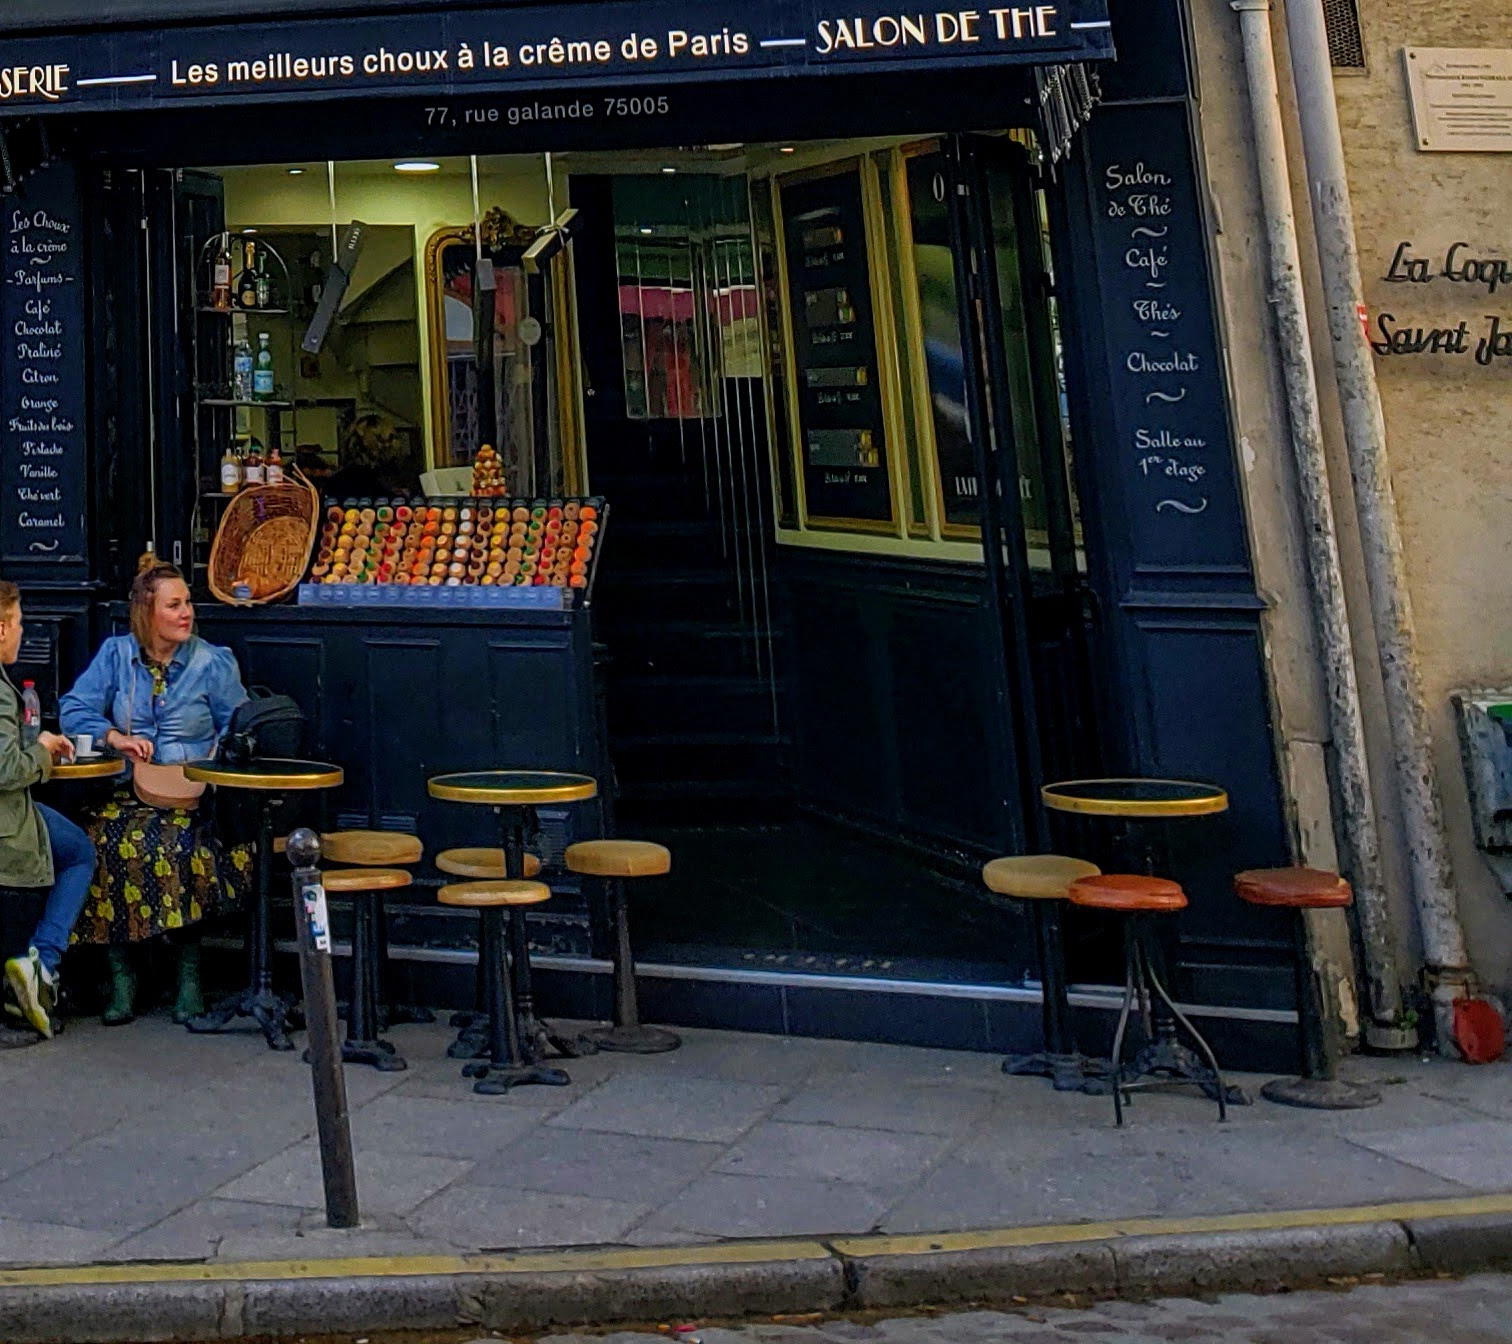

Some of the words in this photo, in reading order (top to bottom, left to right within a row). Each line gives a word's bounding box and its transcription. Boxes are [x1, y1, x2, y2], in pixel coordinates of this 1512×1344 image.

[172, 60, 219, 84] Les
[227, 53, 354, 81] meilleurs
[363, 47, 448, 73] choux
[458, 43, 474, 68] à
[484, 41, 509, 67] la
[519, 37, 611, 65] crême
[621, 33, 658, 60] de
[668, 28, 748, 57] Paris
[816, 14, 925, 53] SALON
[935, 11, 980, 42] DE
[989, 6, 1057, 39] THE
[425, 107, 456, 126] 77,
[465, 108, 499, 123] rue
[508, 100, 594, 125] galande
[604, 96, 669, 116] 75005
[1105, 162, 1171, 189] Salon
[1108, 201, 1126, 216] de
[1128, 194, 1171, 215] Thé
[10, 210, 30, 233] Les
[33, 211, 70, 233] Choux
[22, 235, 35, 253] la
[1125, 246, 1168, 278] Café
[1380, 241, 1435, 283] La
[25, 299, 51, 321] Café
[1133, 300, 1181, 320] Thés
[15, 320, 62, 335] Chocolat
[1370, 313, 1470, 355] Saint
[1127, 351, 1199, 372] Chocolat
[22, 368, 59, 383] Citron
[21, 396, 59, 412] Orange
[22, 441, 63, 456] Pistache
[1135, 429, 1181, 449] Salle
[1184, 437, 1206, 448] au
[20, 464, 58, 478] Vanille
[19, 512, 65, 527] Caramel
